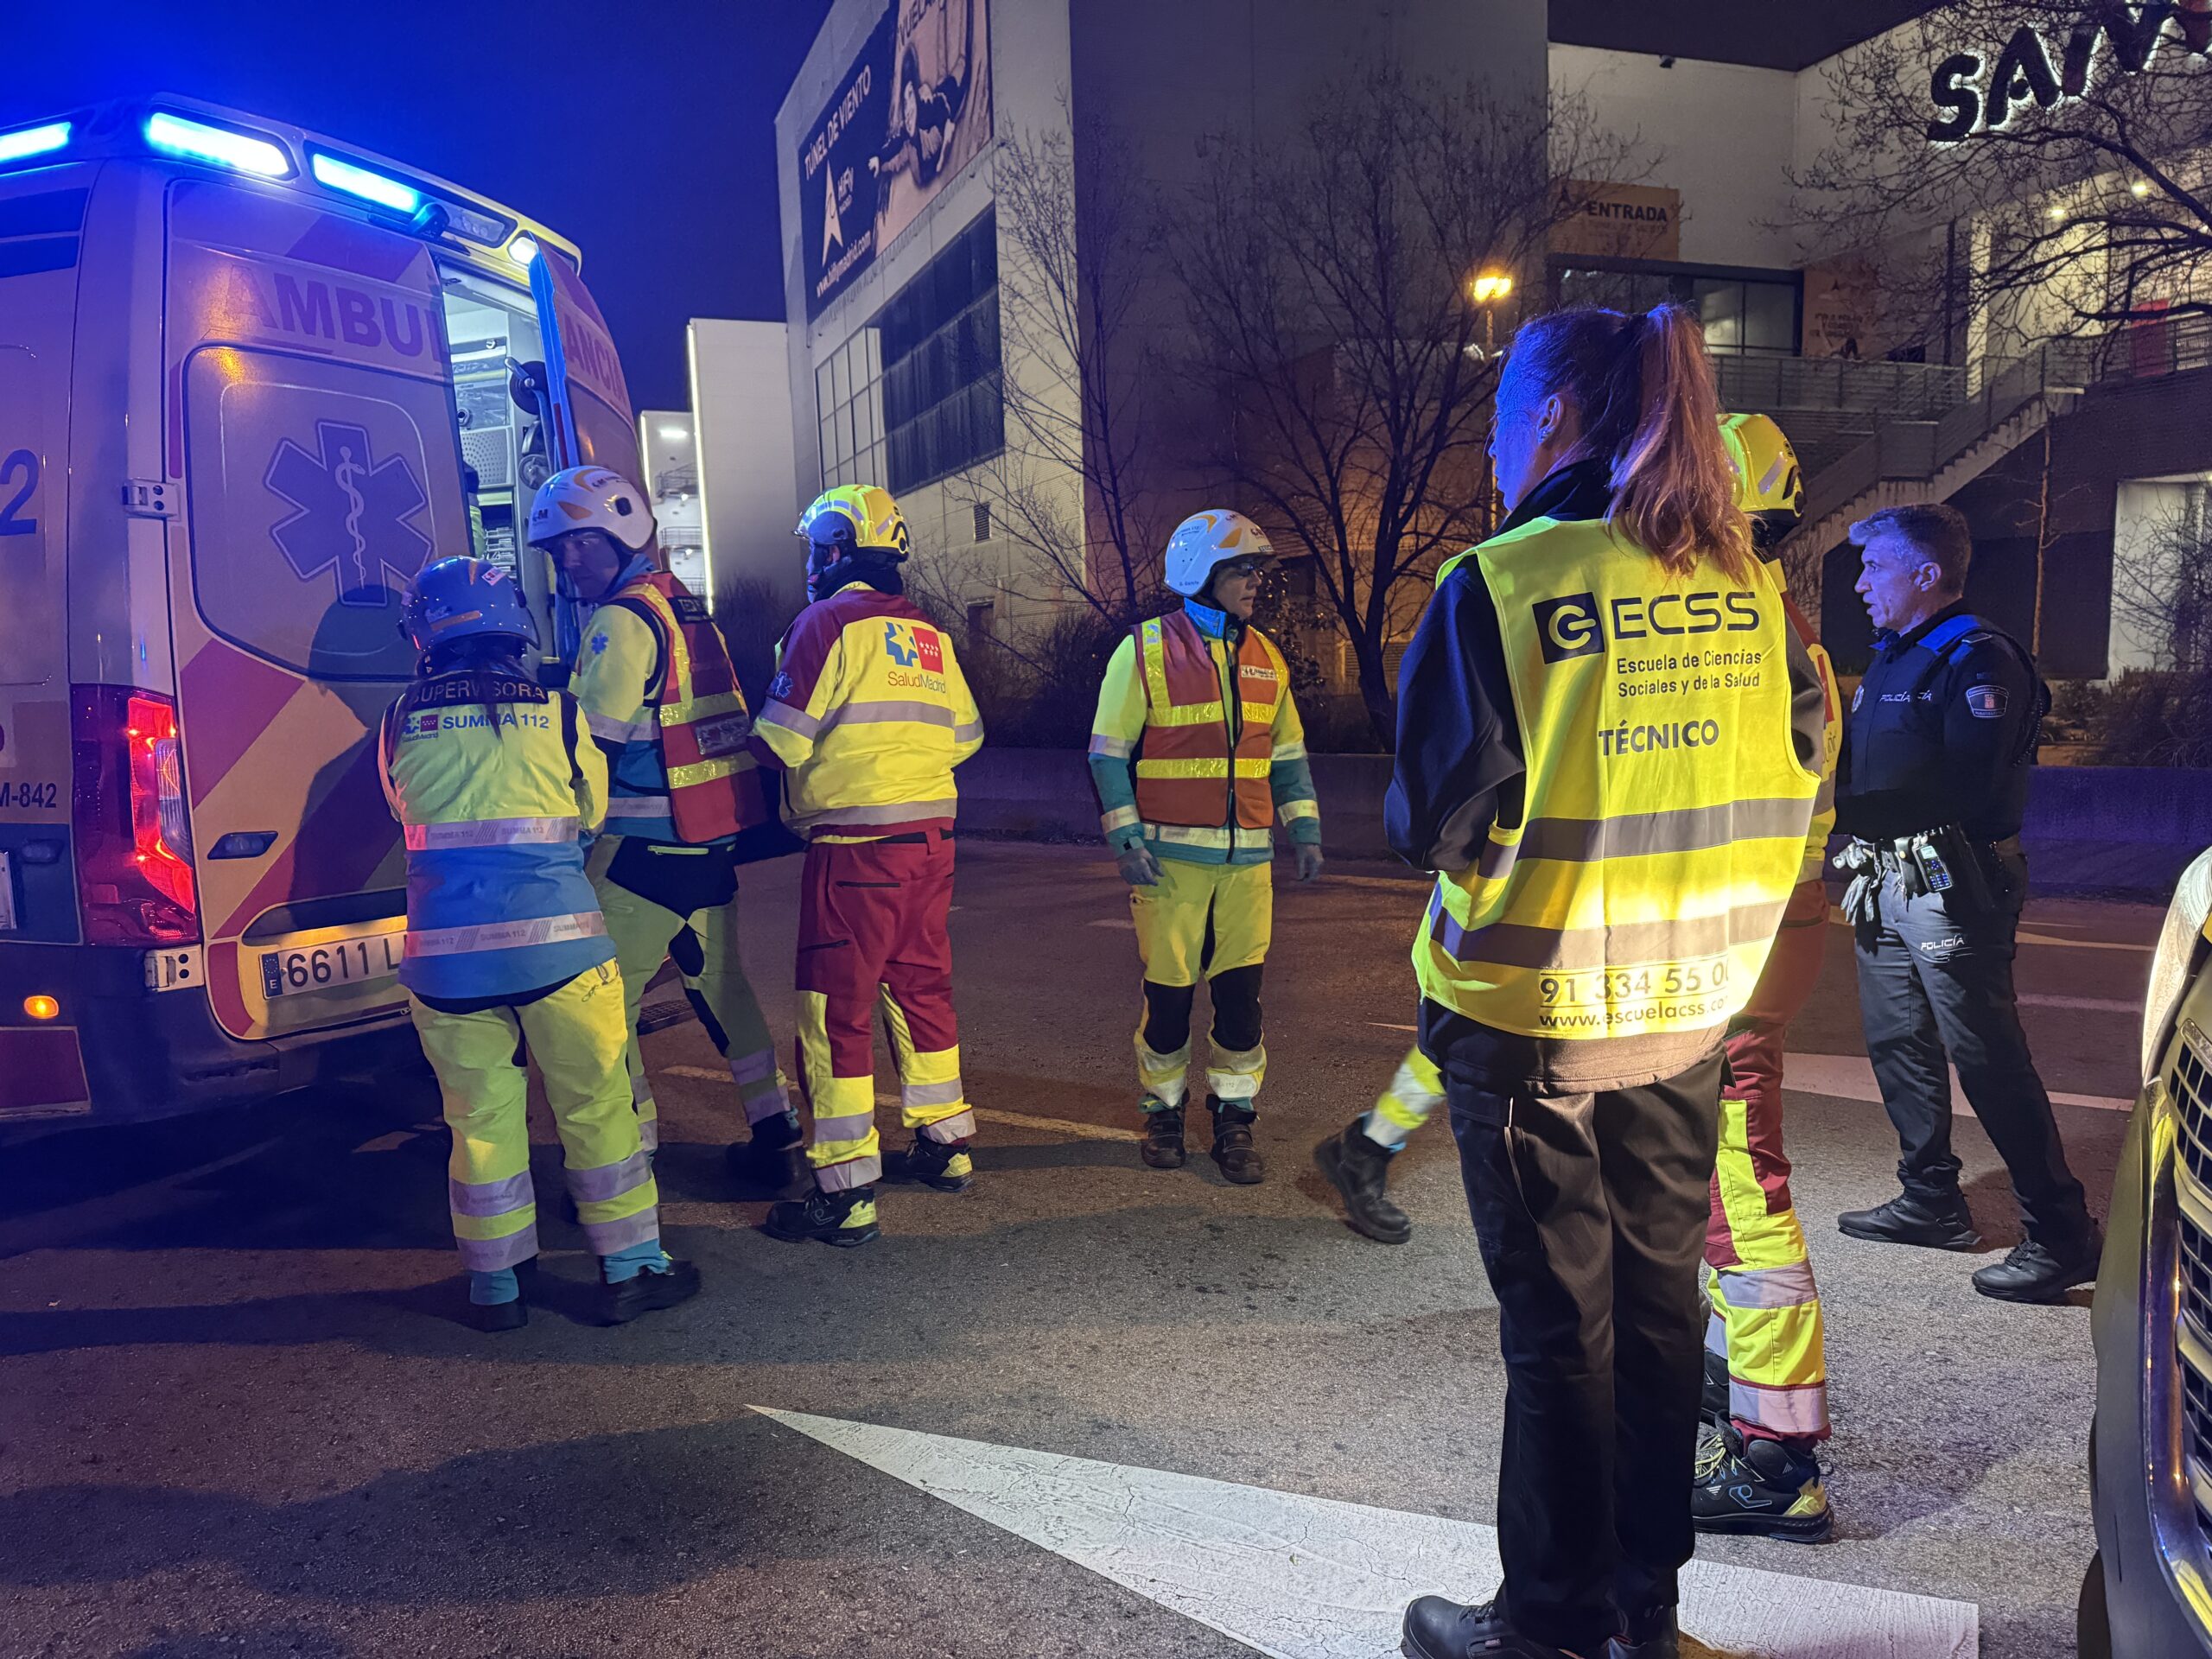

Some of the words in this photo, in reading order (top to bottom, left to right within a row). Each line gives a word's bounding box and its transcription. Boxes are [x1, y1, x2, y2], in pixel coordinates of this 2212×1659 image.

[804, 131, 828, 181] TÚNEL
[828, 111, 839, 148] DE
[839, 64, 871, 130] VIENTO
[1587, 200, 1668, 222] ENTRADA
[1610, 591, 1760, 640] ECSS
[1617, 653, 1678, 675] Escuela
[1681, 652, 1700, 669] de
[1704, 648, 1762, 667] Ciencias
[1618, 677, 1677, 698] Sociales
[1681, 680, 1689, 696] y
[1693, 676, 1708, 691] de
[1710, 674, 1720, 690] la
[1724, 671, 1760, 689] Salud
[520, 713, 550, 729] 112
[1598, 719, 1719, 757] TÉCNICO
[1921, 935, 1965, 950] POLICÍA
[287, 942, 370, 988] 6611
[270, 979, 277, 989] E
[1540, 977, 1575, 1003] 91
[1595, 971, 1651, 1001] 334
[1664, 967, 1701, 994] 55
[1712, 961, 1728, 986] 0
[1540, 995, 1728, 1027] www.escuelacss.co
